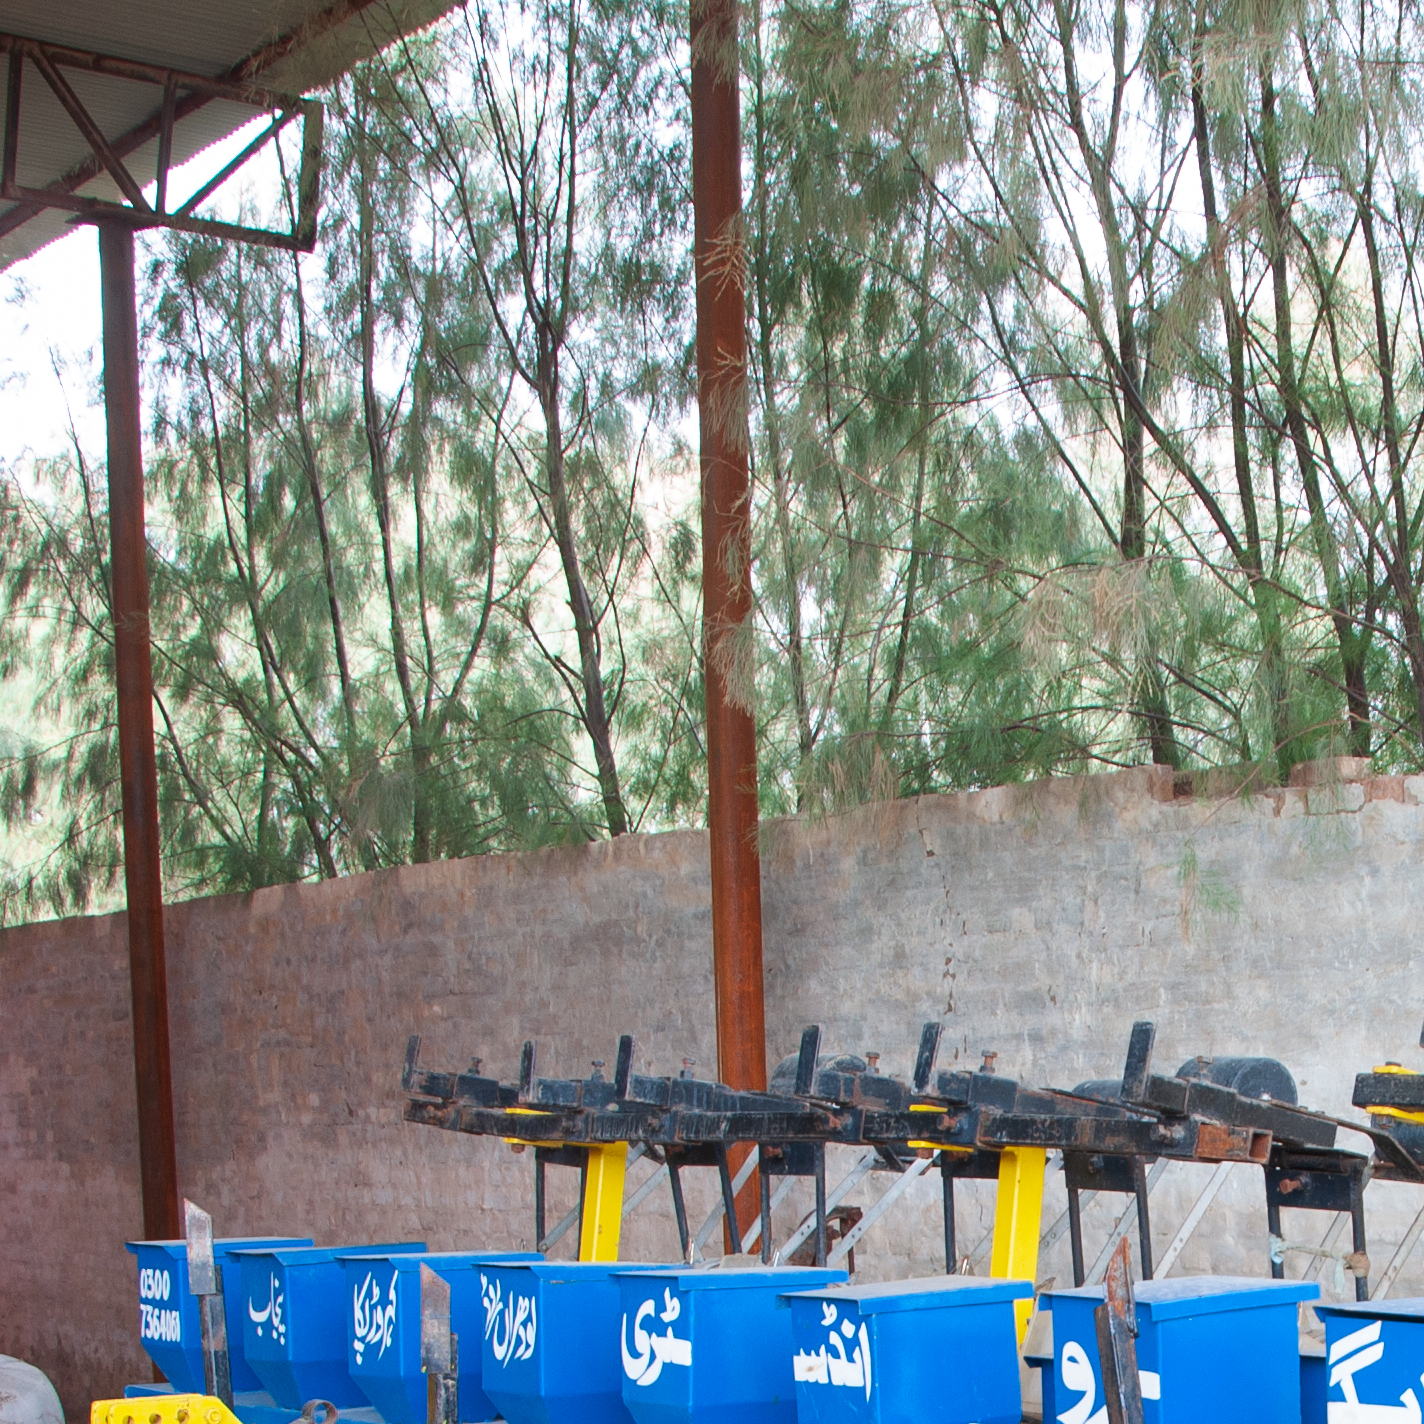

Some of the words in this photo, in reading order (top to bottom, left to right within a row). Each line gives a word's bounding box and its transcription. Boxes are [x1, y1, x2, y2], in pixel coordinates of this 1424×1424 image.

[139, 1268, 171, 1302] 0300
[139, 1303, 182, 1343] 7364061
[248, 1271, 286, 1346] پنجاب
